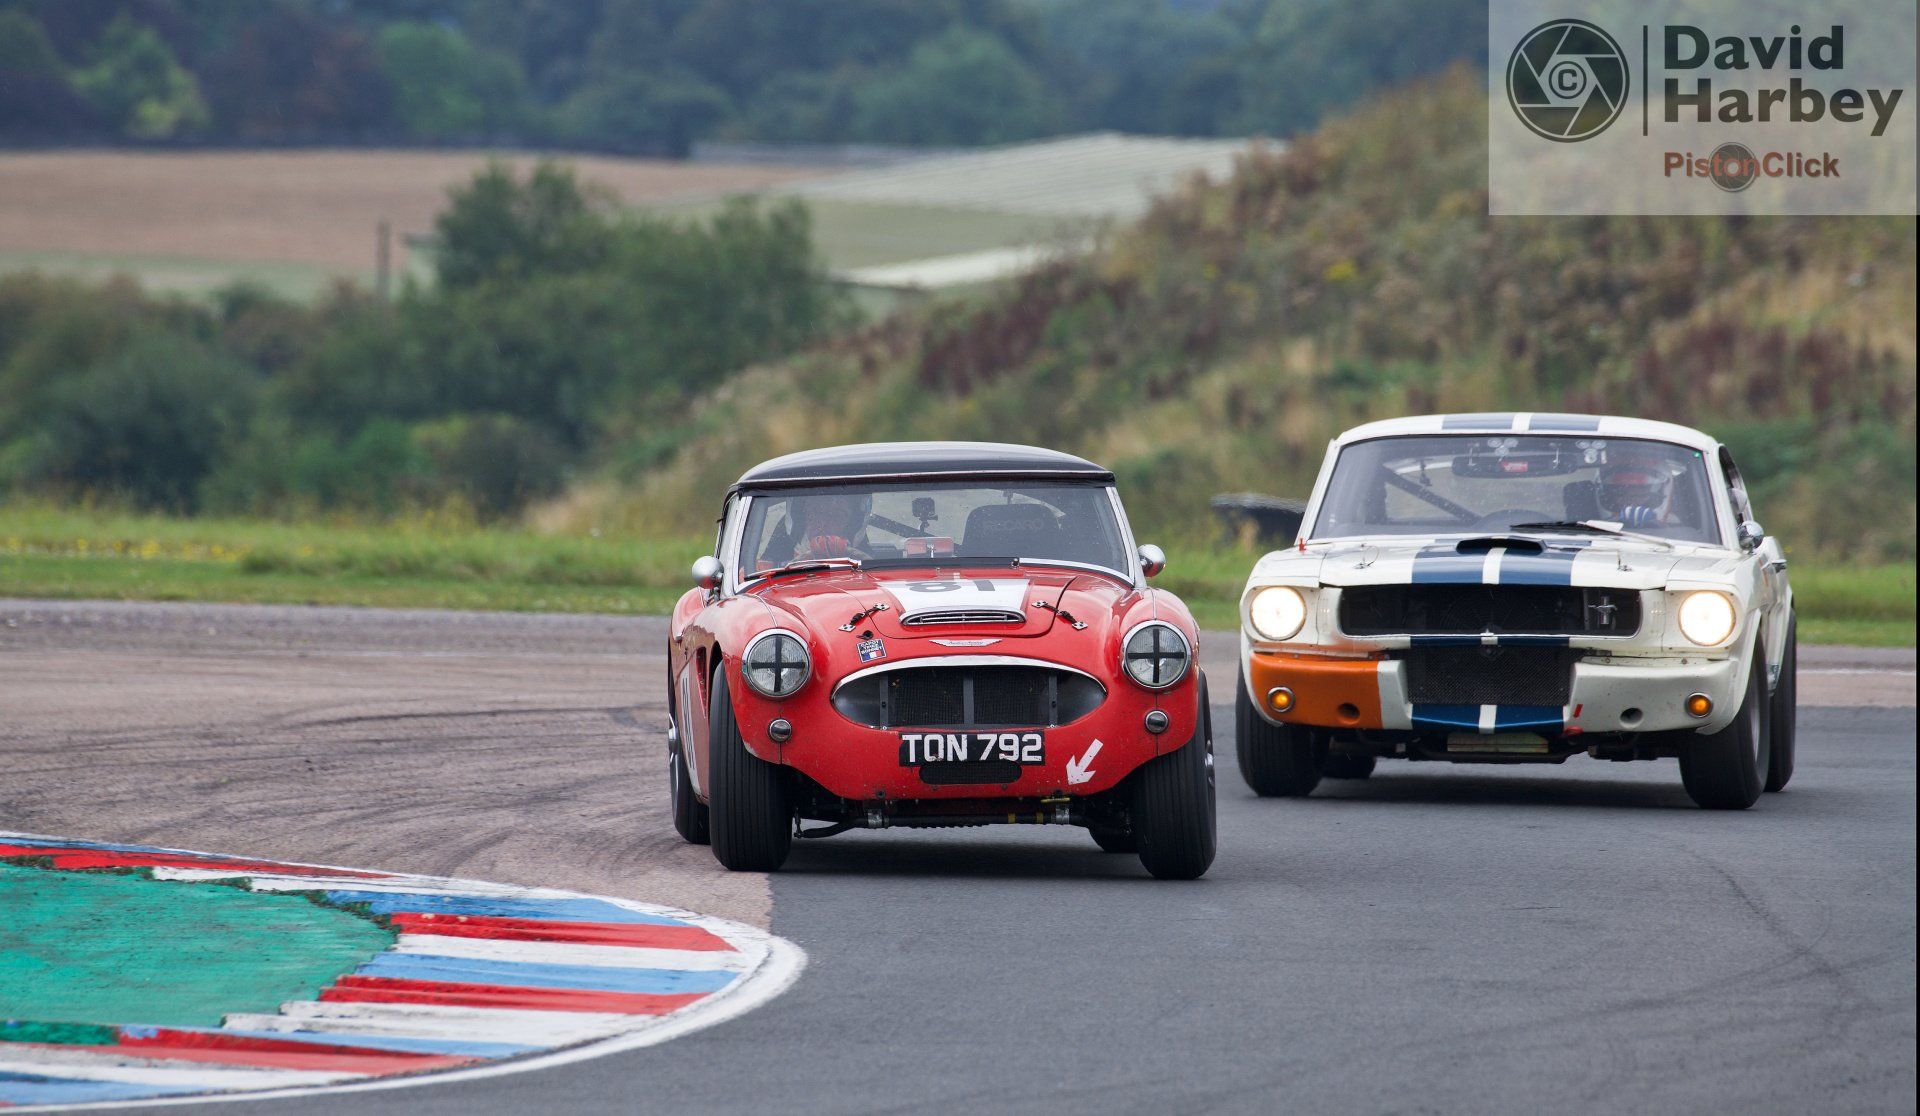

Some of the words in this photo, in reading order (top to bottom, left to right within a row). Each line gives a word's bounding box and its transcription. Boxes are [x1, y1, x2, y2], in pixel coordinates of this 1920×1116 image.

[905, 580, 996, 593] 81
[901, 734, 968, 763] TON
[977, 733, 1042, 762] 792
